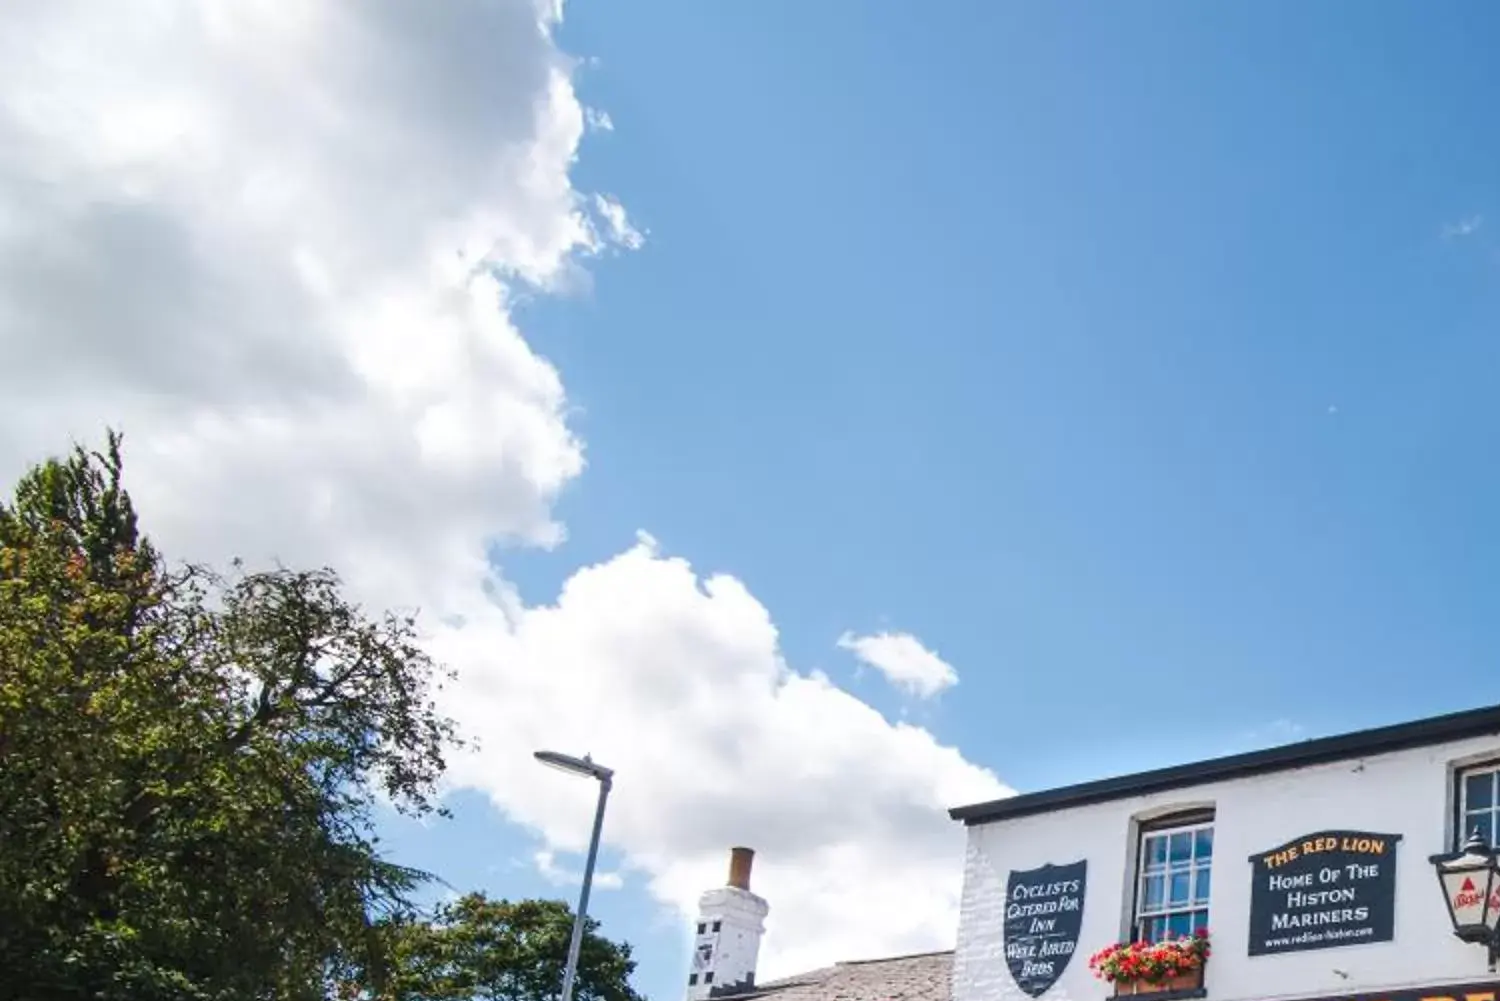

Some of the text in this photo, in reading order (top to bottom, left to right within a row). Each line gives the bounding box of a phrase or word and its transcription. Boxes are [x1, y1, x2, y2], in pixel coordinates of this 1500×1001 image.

[1264, 837, 1385, 869] THE RED LION
[1269, 863, 1379, 891] HOME OF THE
[1012, 880, 1080, 900] CYCLISTS
[1287, 887, 1355, 909] HISTON
[1029, 918, 1056, 934] INN
[1271, 906, 1369, 931] MARINERS
[1038, 940, 1075, 958] AIRED
[1021, 960, 1055, 977] BEDS
